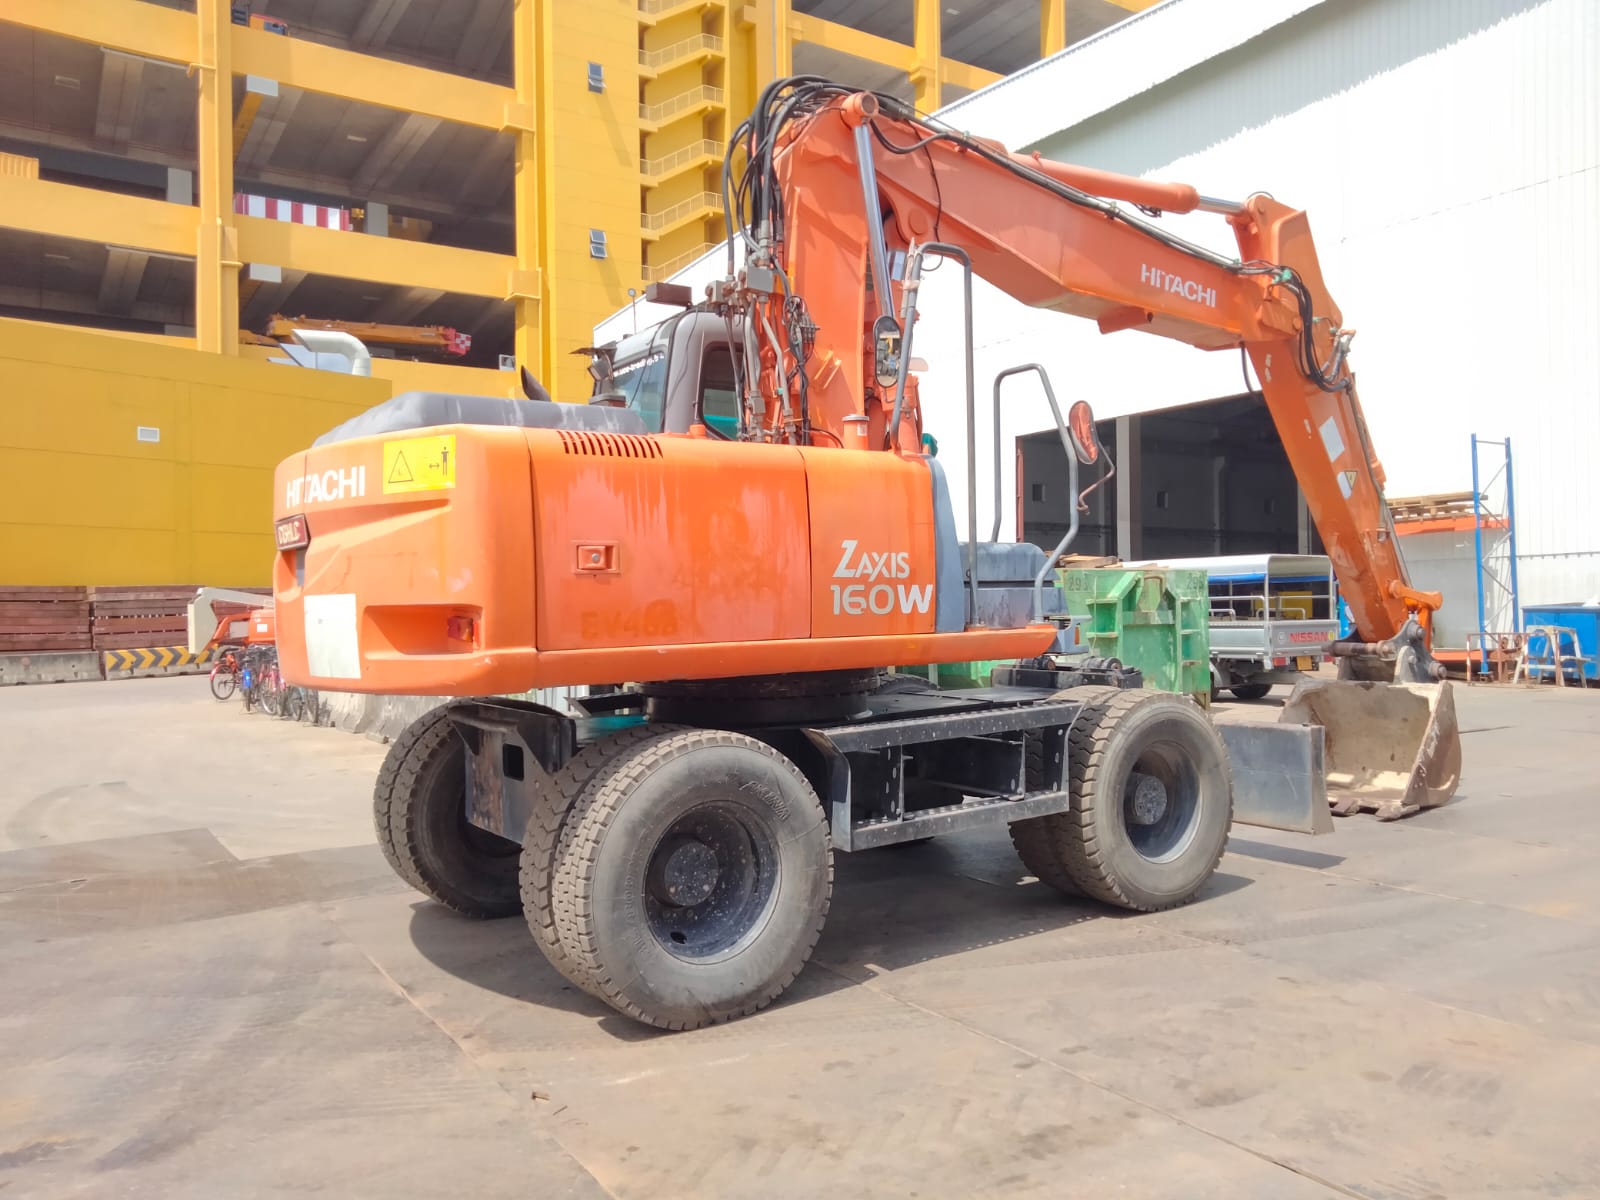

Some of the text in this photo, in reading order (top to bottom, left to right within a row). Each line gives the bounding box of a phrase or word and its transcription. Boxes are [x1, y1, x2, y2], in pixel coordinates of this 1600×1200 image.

[1140, 263, 1216, 308] HITACHI
[286, 465, 366, 509] HITACHI
[832, 539, 910, 582] ZAXIS
[830, 583, 933, 615] 160W
[1289, 631, 1328, 643] NISSAN
